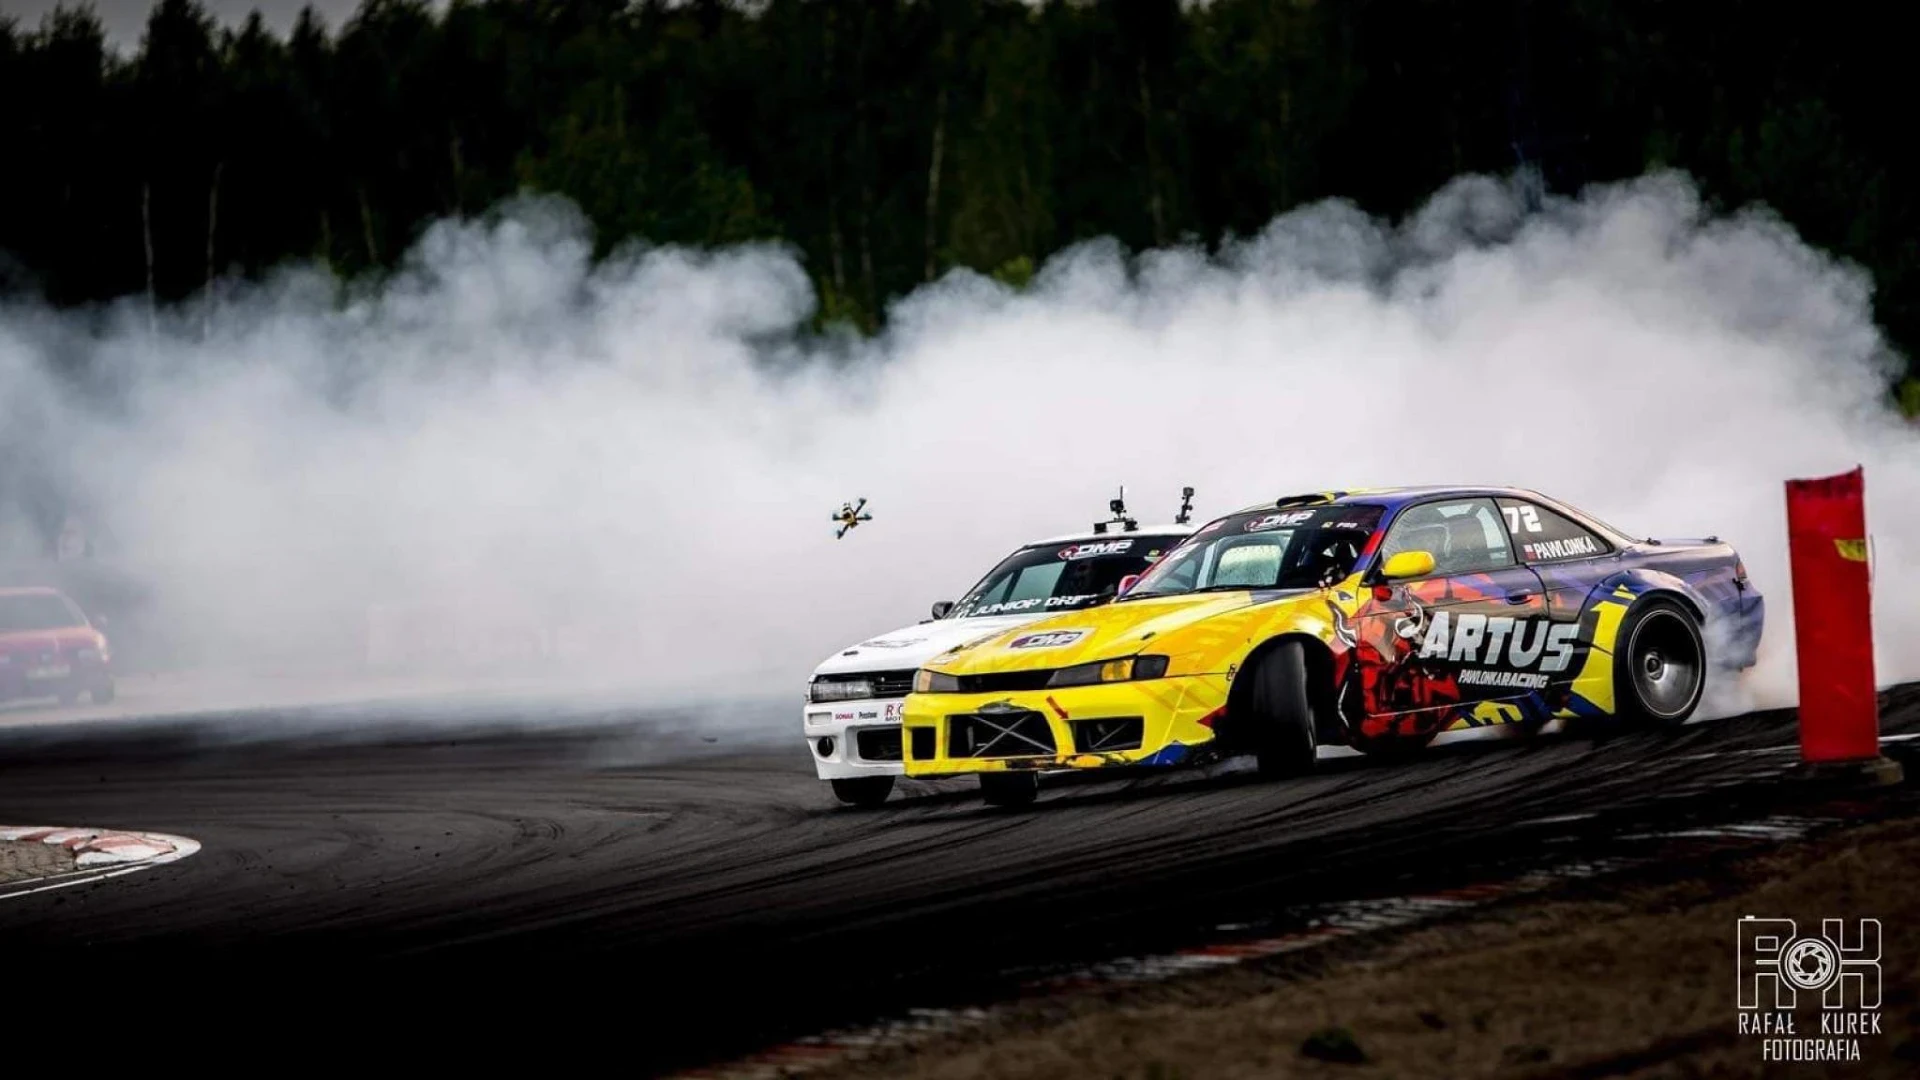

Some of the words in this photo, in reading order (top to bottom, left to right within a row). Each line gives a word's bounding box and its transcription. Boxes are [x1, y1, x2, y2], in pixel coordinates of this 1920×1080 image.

[1502, 505, 1542, 534] 72
[1079, 540, 1134, 554] DMP
[1533, 536, 1597, 559] PAWLONKA
[1418, 611, 1580, 672] ARTUS
